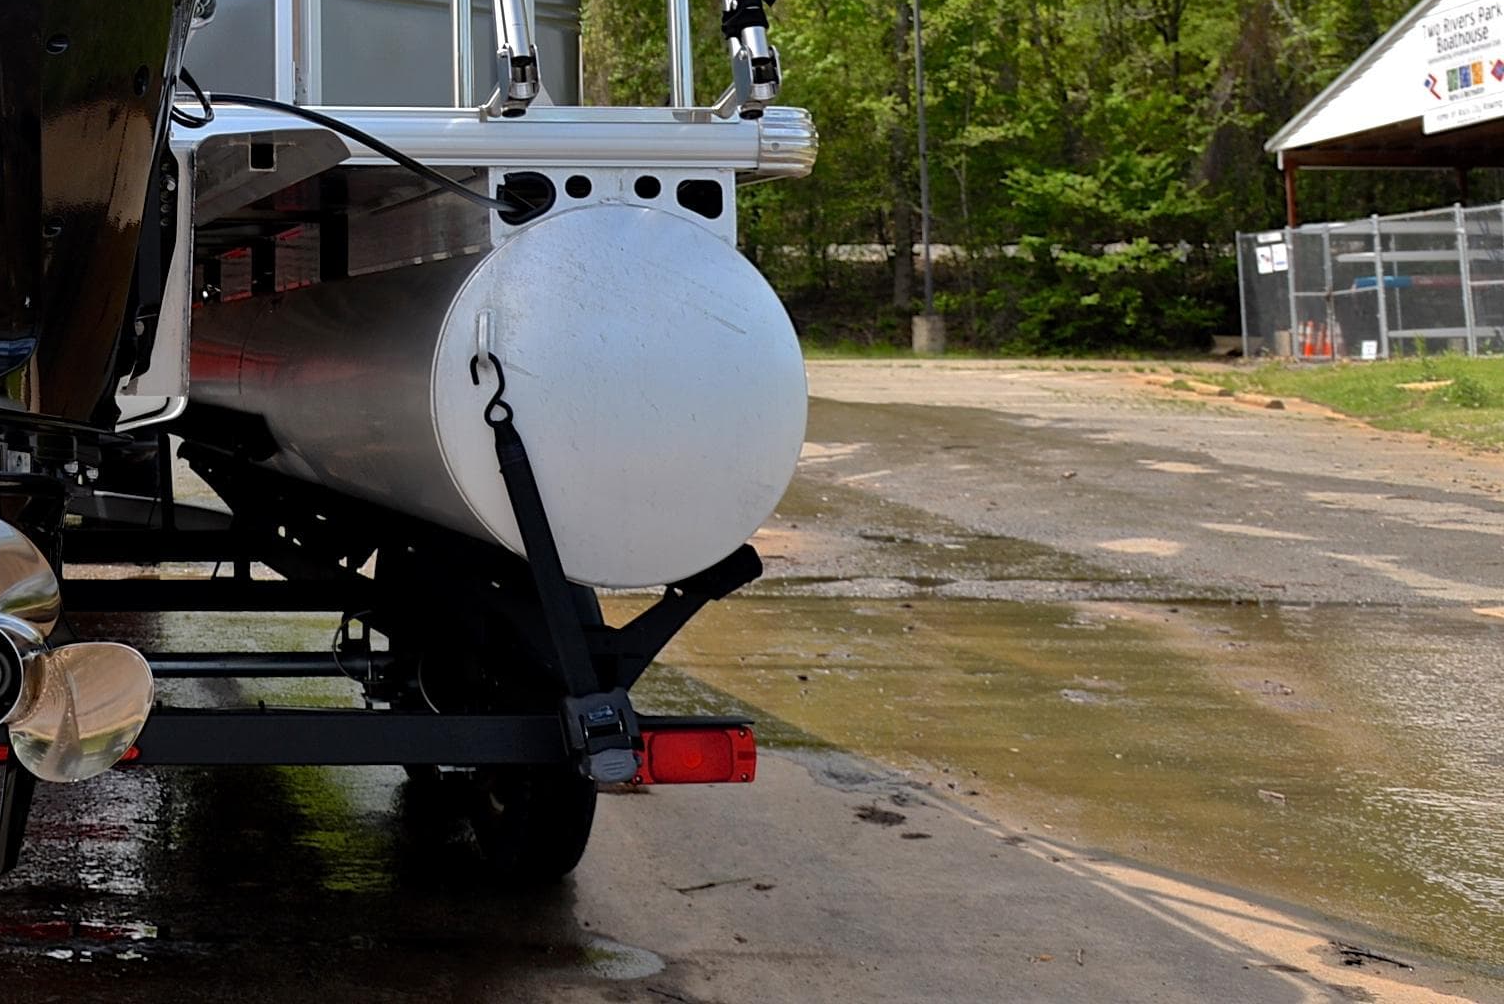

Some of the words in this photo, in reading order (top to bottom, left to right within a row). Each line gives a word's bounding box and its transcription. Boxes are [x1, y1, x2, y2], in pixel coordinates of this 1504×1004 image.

[1444, 12, 1475, 34] Rivers
[1479, 2, 1503, 23] Park
[1436, 25, 1489, 54] Boathouse
